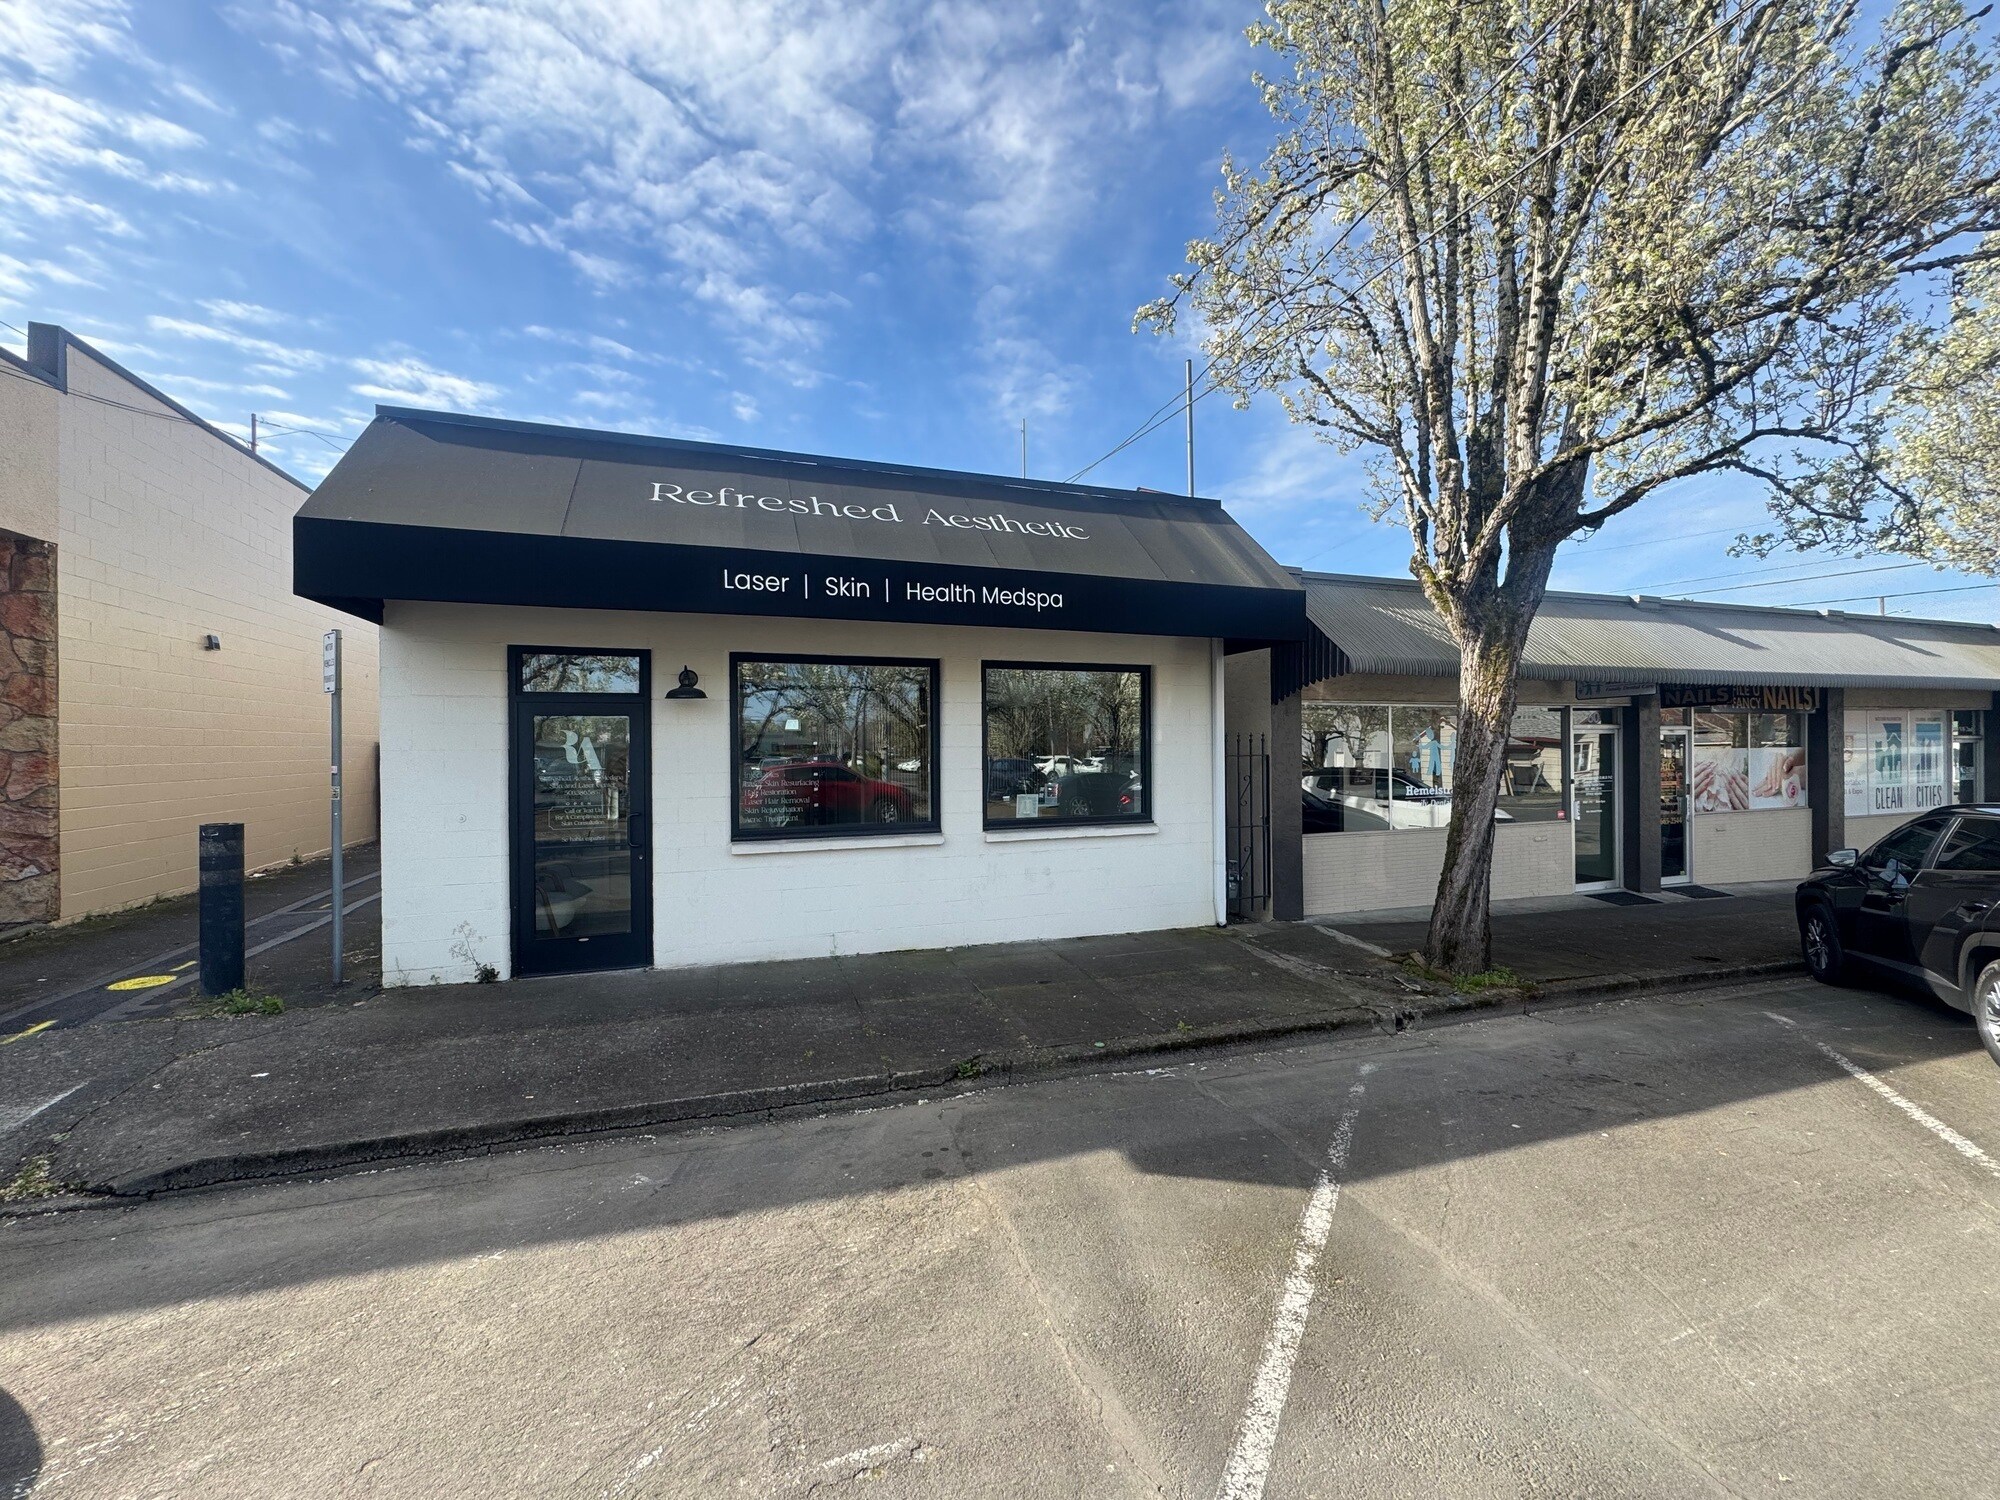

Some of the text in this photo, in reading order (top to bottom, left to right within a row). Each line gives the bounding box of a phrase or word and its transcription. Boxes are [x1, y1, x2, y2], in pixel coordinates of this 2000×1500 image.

[650, 482, 1091, 540] Refreshed Aesthetic
[723, 569, 790, 594] Laser
[825, 577, 870, 598] Skin
[906, 582, 976, 604] Health
[982, 586, 1064, 612] Medspa
[1665, 687, 1729, 705] NAILS
[1732, 697, 1761, 709] FANCY
[1763, 685, 1813, 710] NAILS
[1875, 785, 1942, 809] CLEAN CITIES
